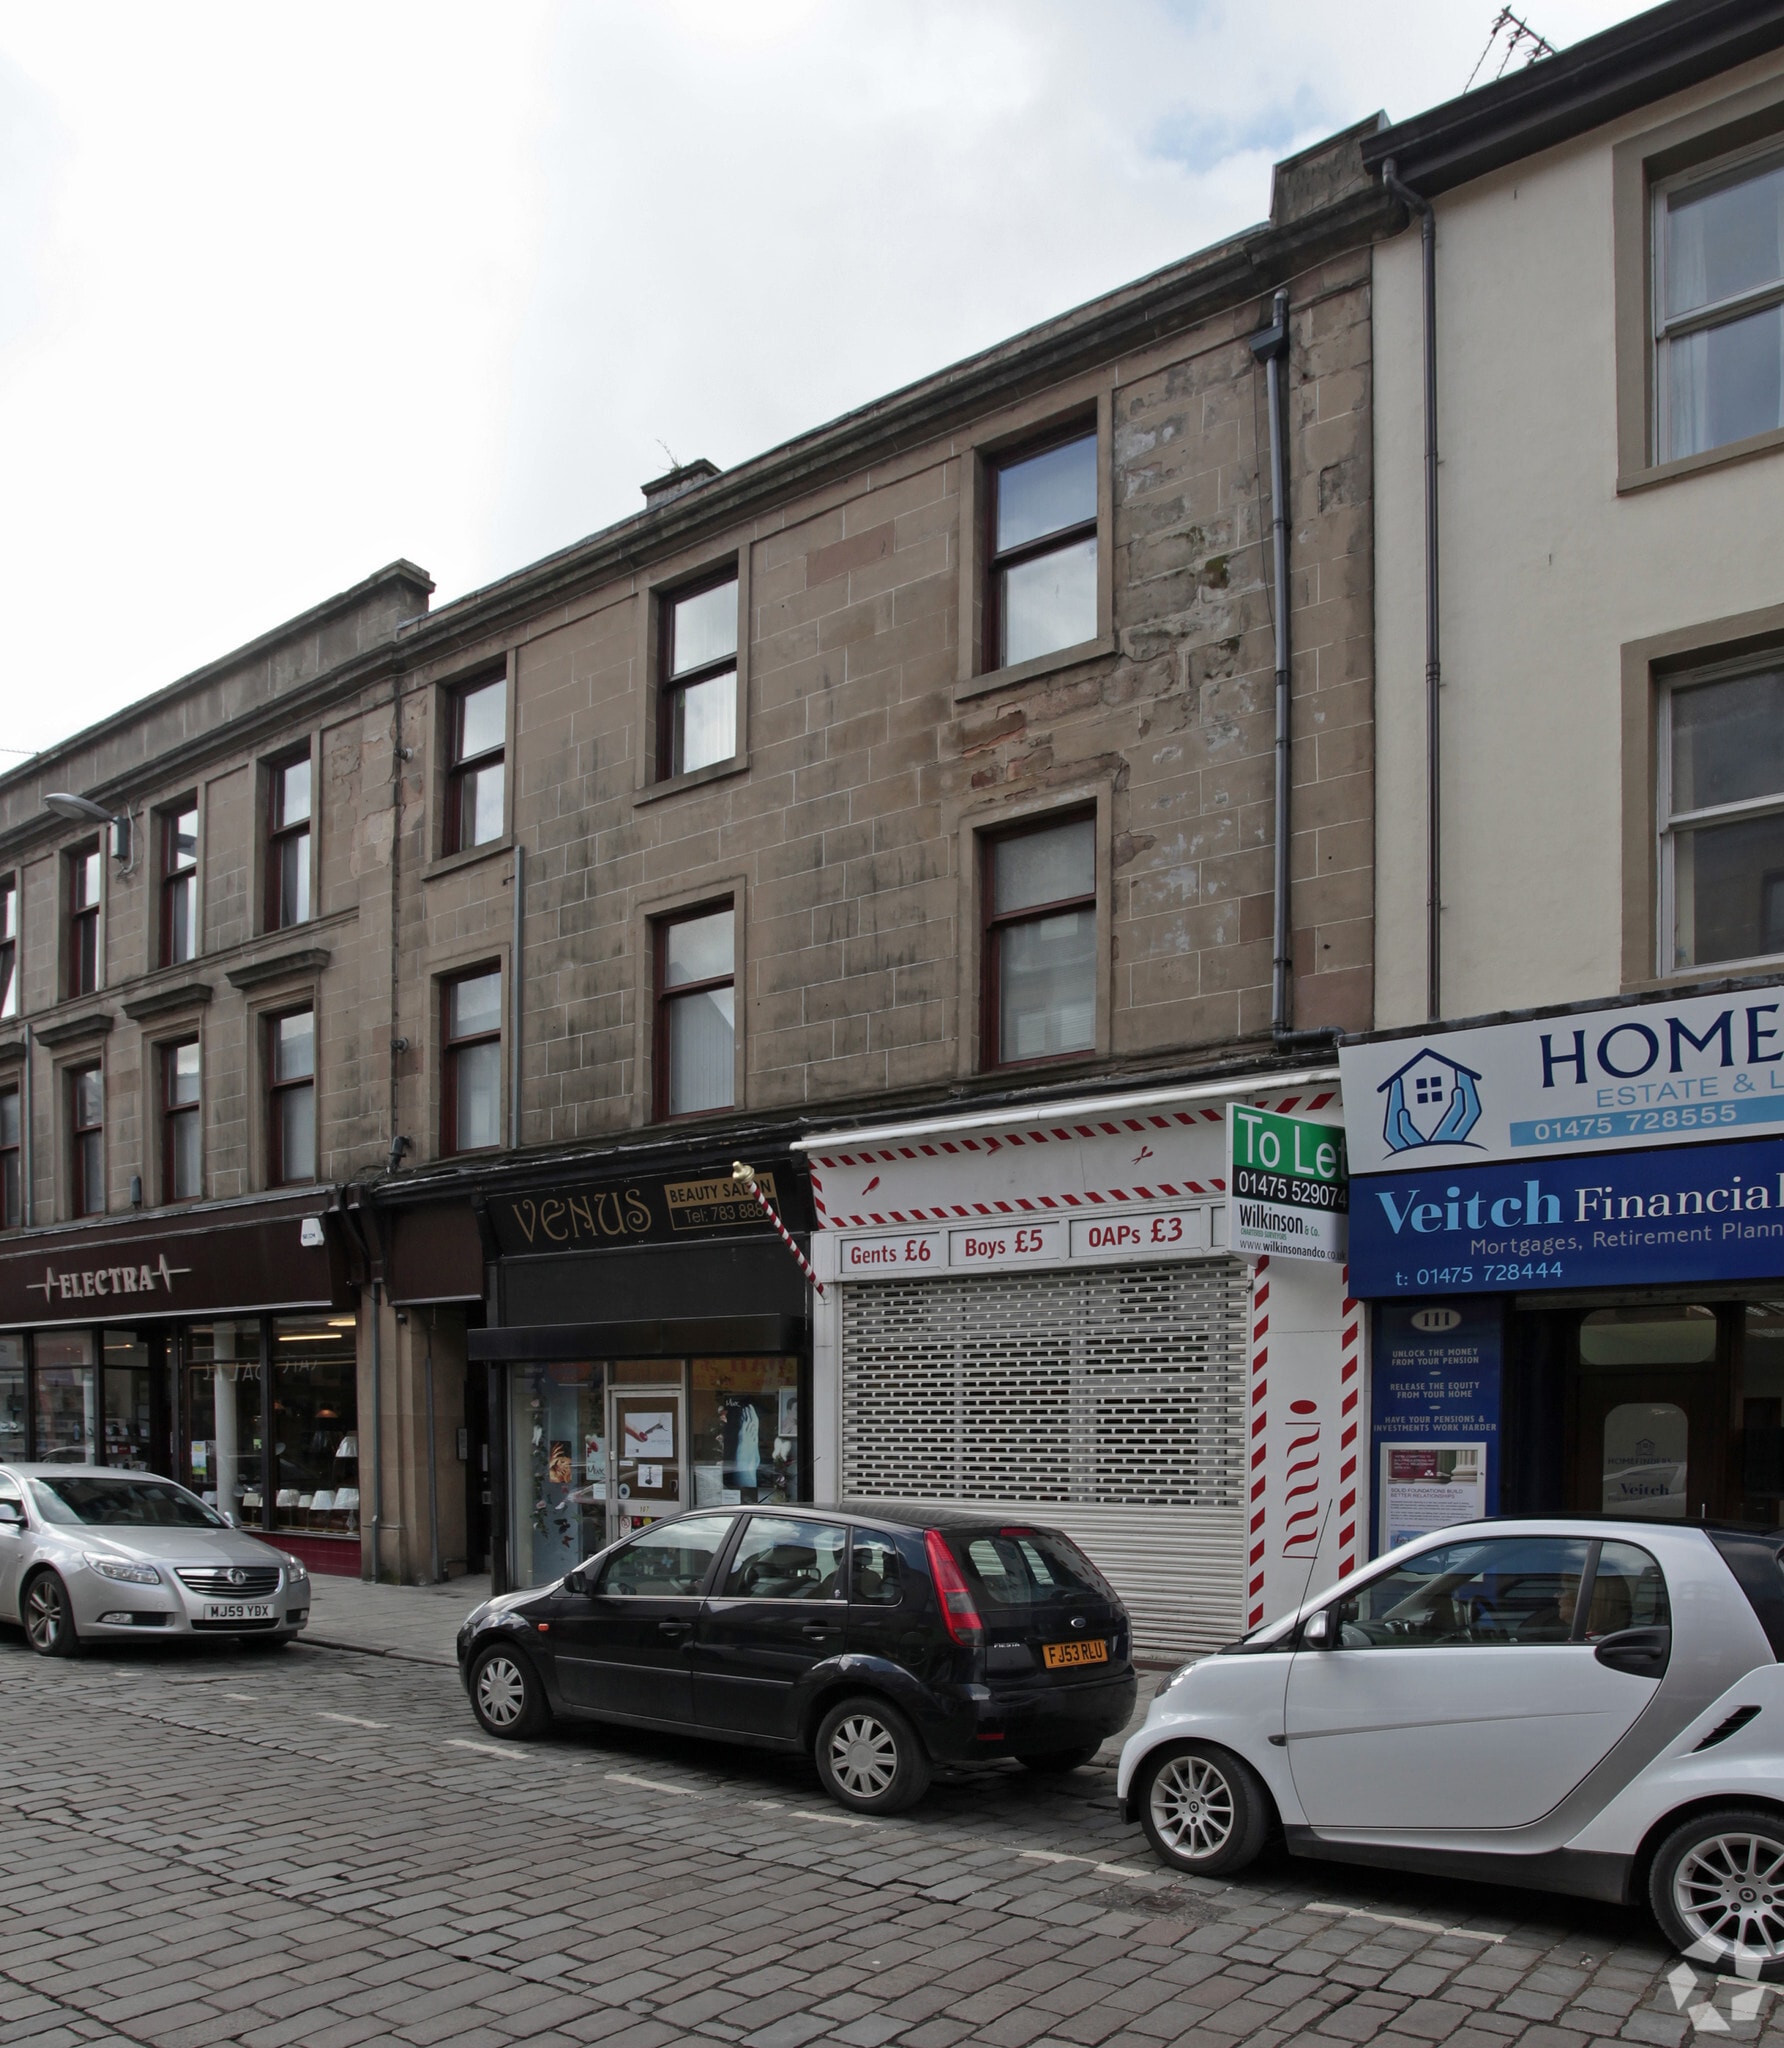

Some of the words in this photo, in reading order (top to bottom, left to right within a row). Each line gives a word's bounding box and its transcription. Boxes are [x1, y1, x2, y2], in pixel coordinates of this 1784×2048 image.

[1539, 1003, 1784, 1088] HOME
[1596, 1076, 1719, 1108] ESTATE
[1732, 1073, 1756, 1093] &
[1534, 1117, 1612, 1140] 01475
[1626, 1104, 1737, 1131] 728555
[1238, 1112, 1280, 1168] To
[669, 1184, 718, 1203] BEAUTY
[722, 1179, 772, 1198] SALN
[1239, 1171, 1287, 1199] 01475
[1291, 1180, 1347, 1208] 529074
[684, 1209, 709, 1223] Tel:
[710, 1204, 736, 1221] 783
[1375, 1180, 1563, 1234] Veitch
[1088, 1224, 1141, 1248] OAPs
[1150, 1217, 1183, 1243] £3
[1240, 1204, 1303, 1234] Wilkinson
[1304, 1225, 1309, 1236] &
[850, 1246, 897, 1265] Gents
[905, 1239, 931, 1262] £6
[965, 1238, 1006, 1259] Boys
[1014, 1229, 1044, 1254] £5
[1470, 1236, 1583, 1257] Mortgages,
[1593, 1222, 1711, 1248] Retirement
[59, 1264, 155, 1299] ELECTRA
[1395, 1271, 1409, 1286] t:
[1416, 1266, 1473, 1285] 01475
[1484, 1261, 1563, 1281] 728444
[1391, 1358, 1414, 1366] FROM
[1418, 1357, 1439, 1365] YOUR
[1442, 1356, 1479, 1364] PENSION
[1392, 1349, 1425, 1358] UNLOCK
[1448, 1348, 1478, 1356] MONEY
[1390, 1383, 1425, 1391] RELEASE
[1429, 1382, 1444, 1390] THE
[1448, 1381, 1480, 1390] EQUITY
[1423, 1390, 1444, 1398] YOUR
[1448, 1390, 1472, 1398] HOME
[1374, 1424, 1429, 1432] INVESTMENTS
[1462, 1423, 1496, 1431] HARDER
[1408, 1415, 1430, 1423] YOUR
[1434, 1415, 1474, 1423] PENSIONS
[1620, 1483, 1669, 1495] Veitch
[210, 1606, 244, 1617] MJ59
[1048, 1645, 1080, 1664] FJ53
[1081, 1642, 1103, 1660] RLU
